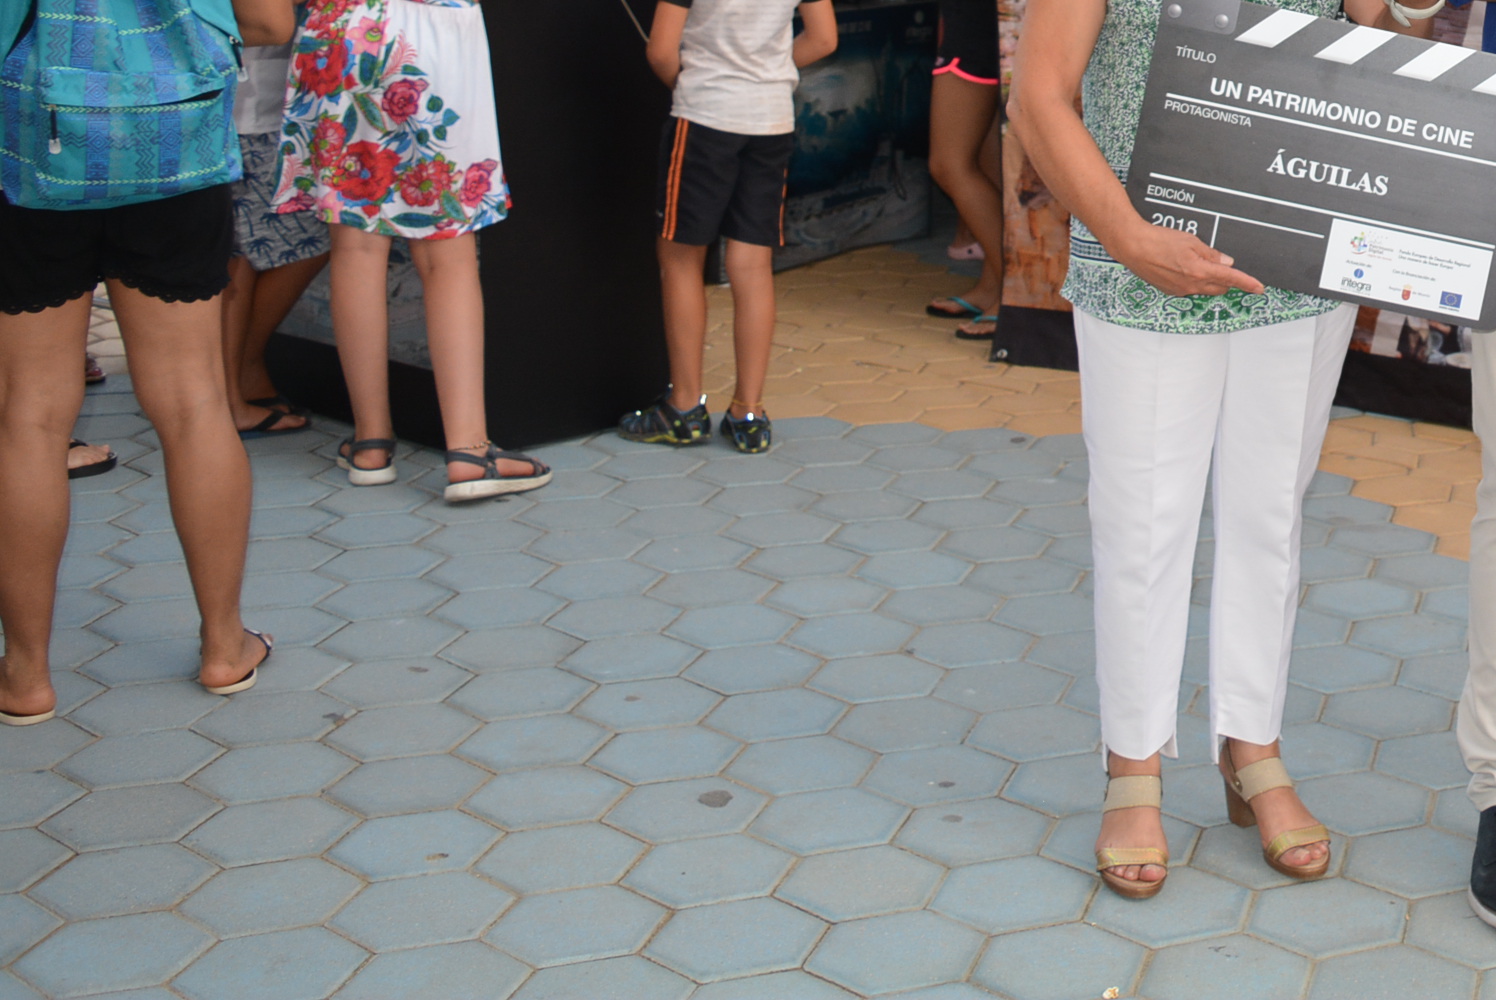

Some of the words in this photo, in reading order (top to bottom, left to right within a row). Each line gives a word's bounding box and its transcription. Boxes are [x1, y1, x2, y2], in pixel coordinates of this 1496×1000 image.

[1175, 45, 1217, 64] TÍTULO
[1163, 100, 1253, 128] PROTAGONISTA
[1209, 77, 1243, 101] UN
[1246, 85, 1382, 130] PATRIMONIO
[1385, 115, 1418, 136] DE
[1421, 122, 1475, 149] CINE
[1266, 149, 1390, 197] ÁGUILAS
[1146, 184, 1195, 204] EDICIÓN
[1151, 212, 1198, 236] 2018
